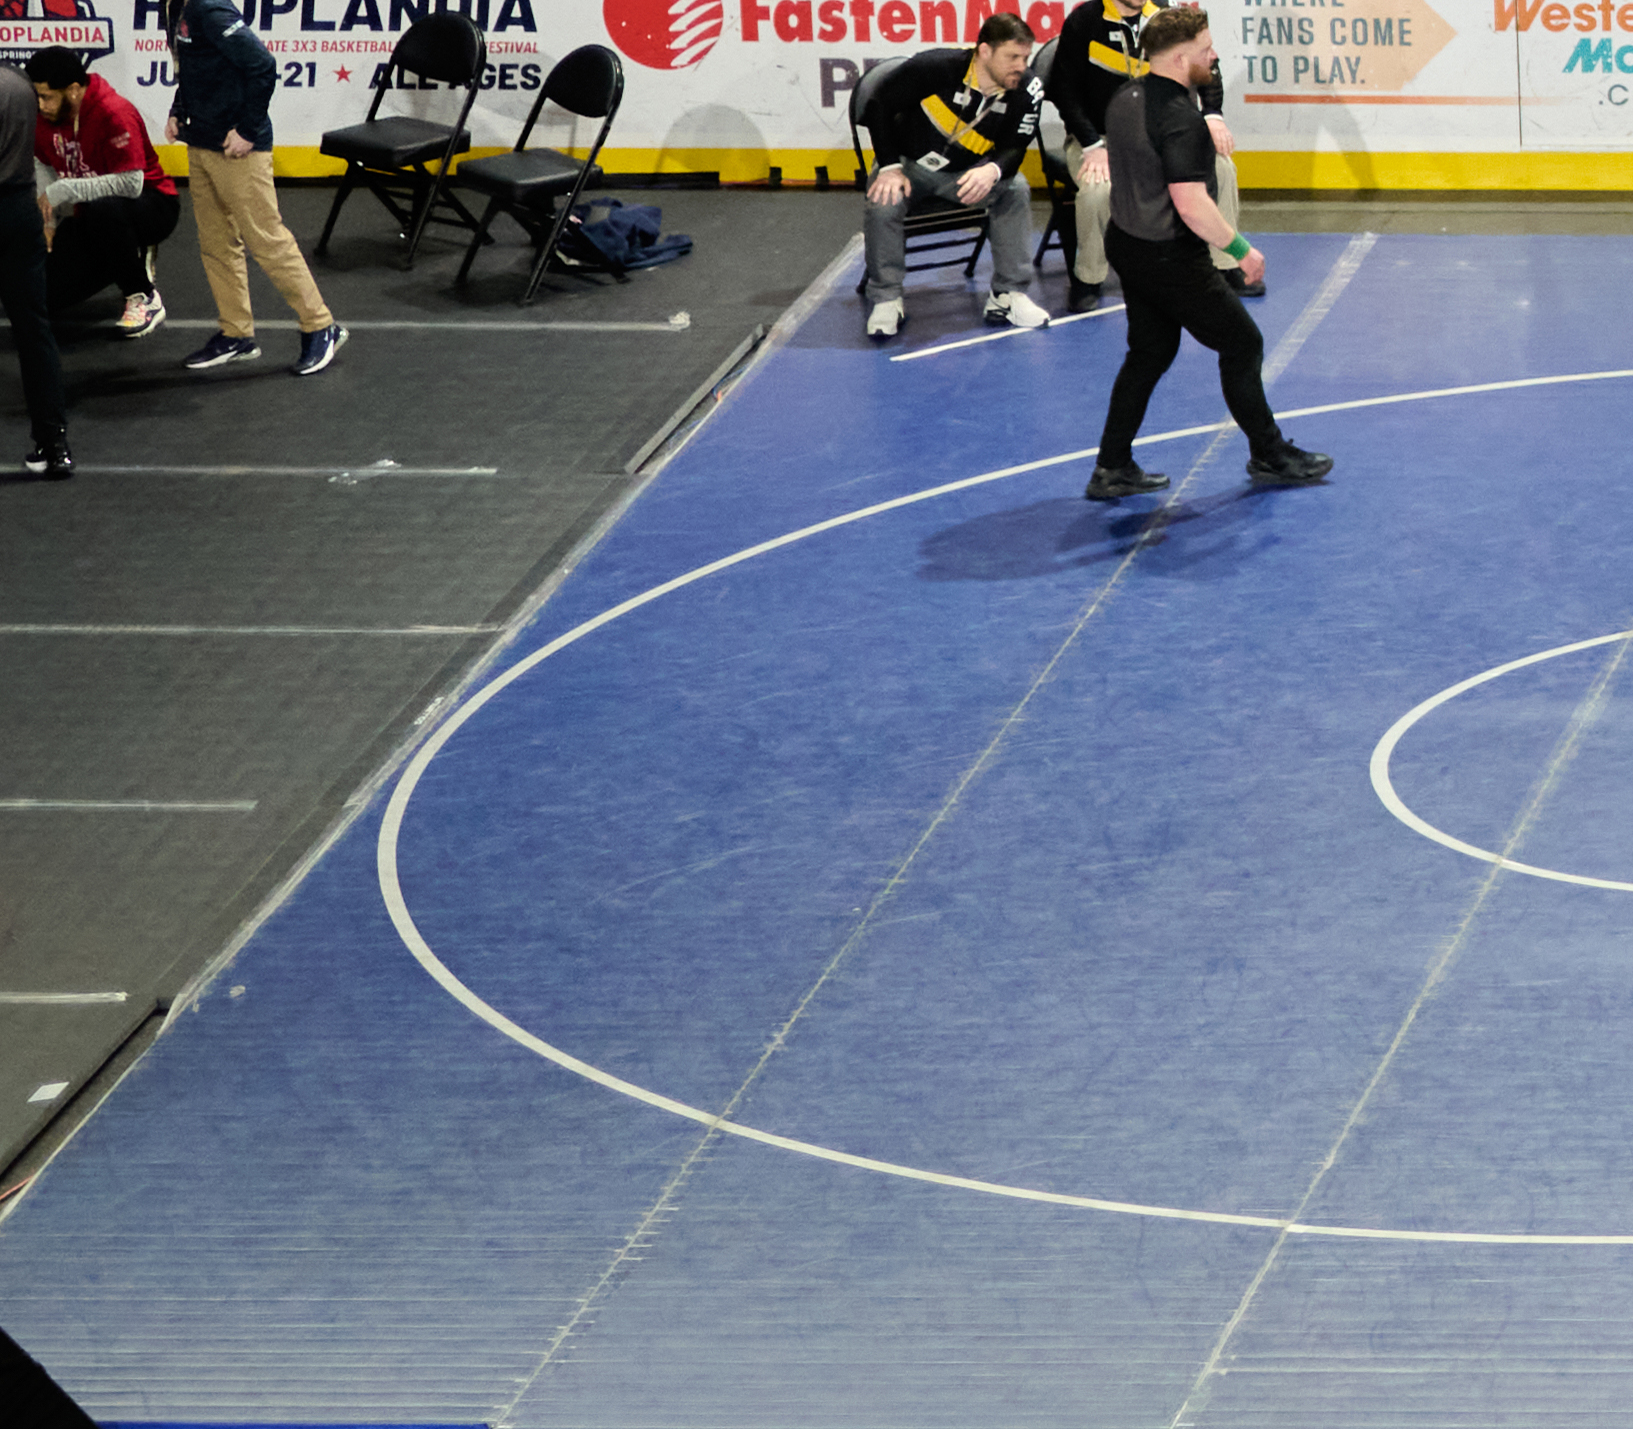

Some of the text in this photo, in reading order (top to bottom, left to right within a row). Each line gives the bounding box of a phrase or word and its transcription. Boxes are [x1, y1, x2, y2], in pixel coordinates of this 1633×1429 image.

[1241, 14, 1413, 47] FANS COME
[292, 40, 318, 53] 3X3
[321, 40, 397, 53] BASKETBAL
[485, 41, 538, 54] ESTIVAL
[1244, 55, 1367, 86] TO PLAY.
